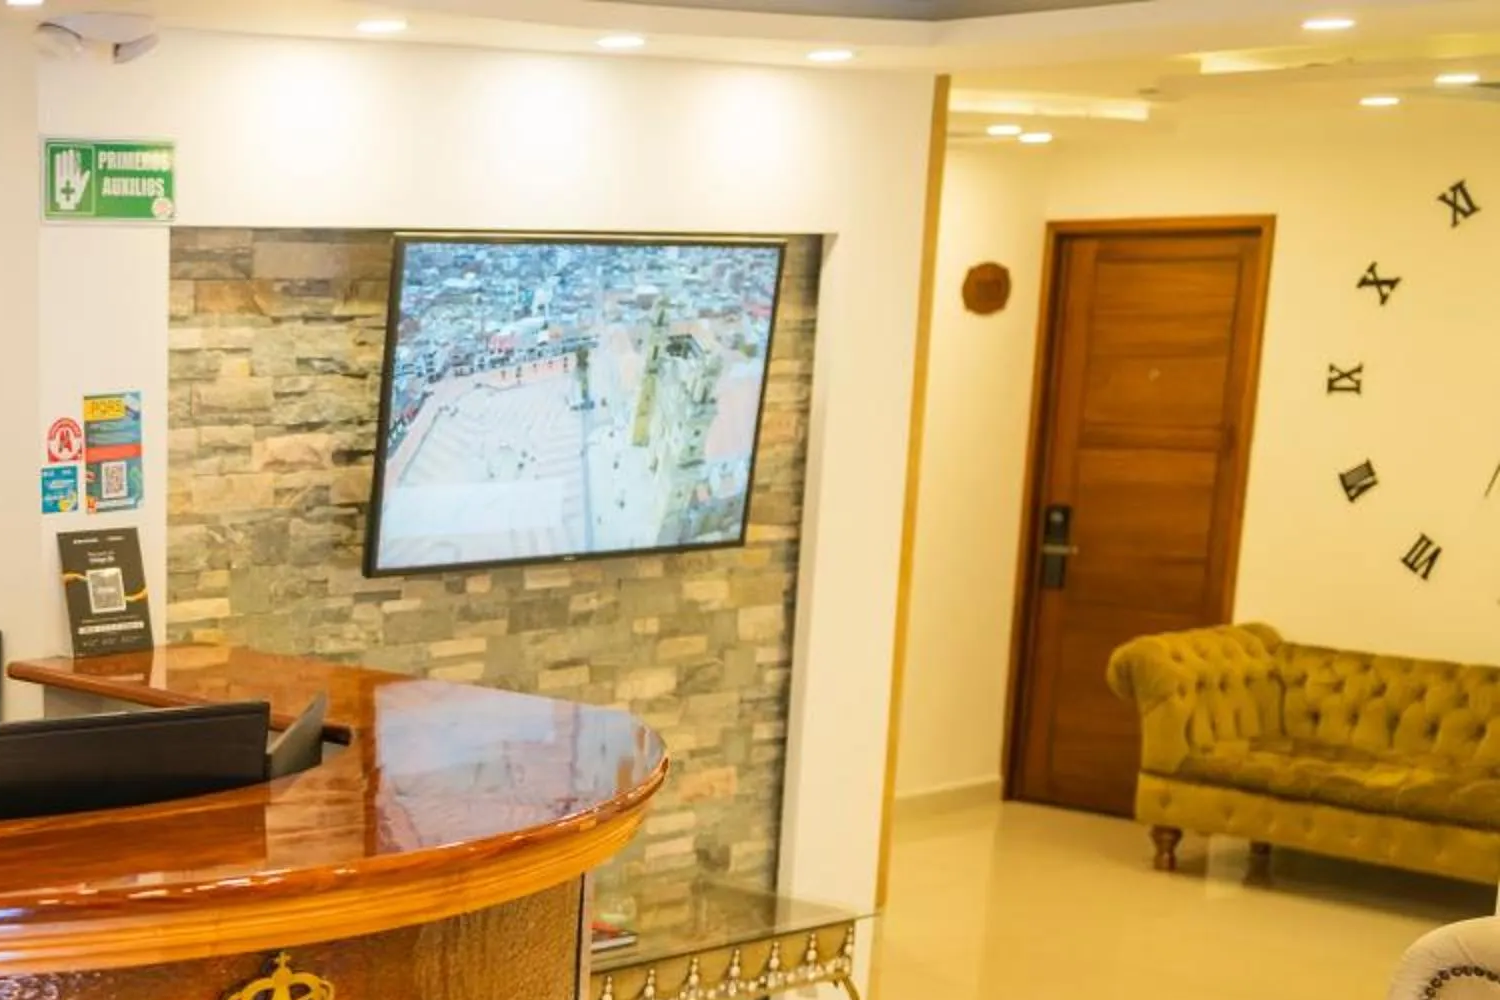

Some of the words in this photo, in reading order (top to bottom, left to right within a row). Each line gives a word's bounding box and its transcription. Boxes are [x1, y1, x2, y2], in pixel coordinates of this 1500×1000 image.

[97, 150, 171, 172] PRIMEROS
[102, 177, 164, 198] AUXILIOS
[1437, 179, 1481, 227] XI
[1357, 261, 1402, 306] X
